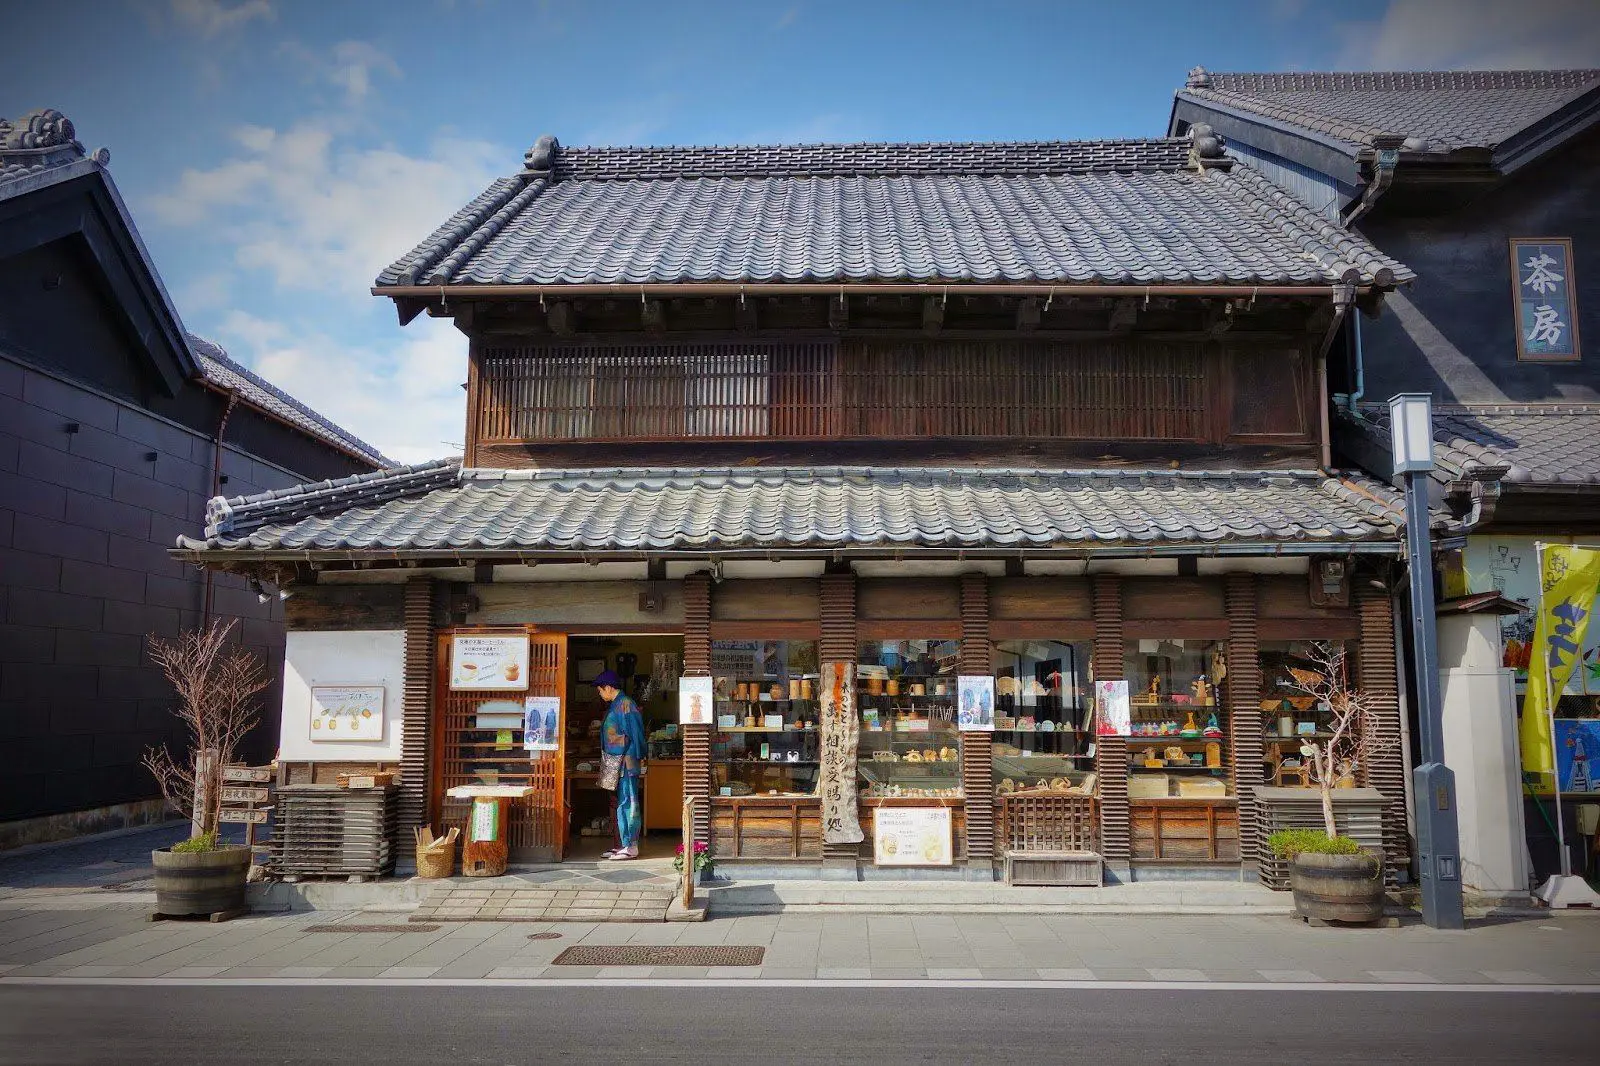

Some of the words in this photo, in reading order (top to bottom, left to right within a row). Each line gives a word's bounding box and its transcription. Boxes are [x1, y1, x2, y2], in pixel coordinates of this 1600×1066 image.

[1522, 253, 1564, 345] 茶房
[219, 811, 256, 821] 町二丁目
